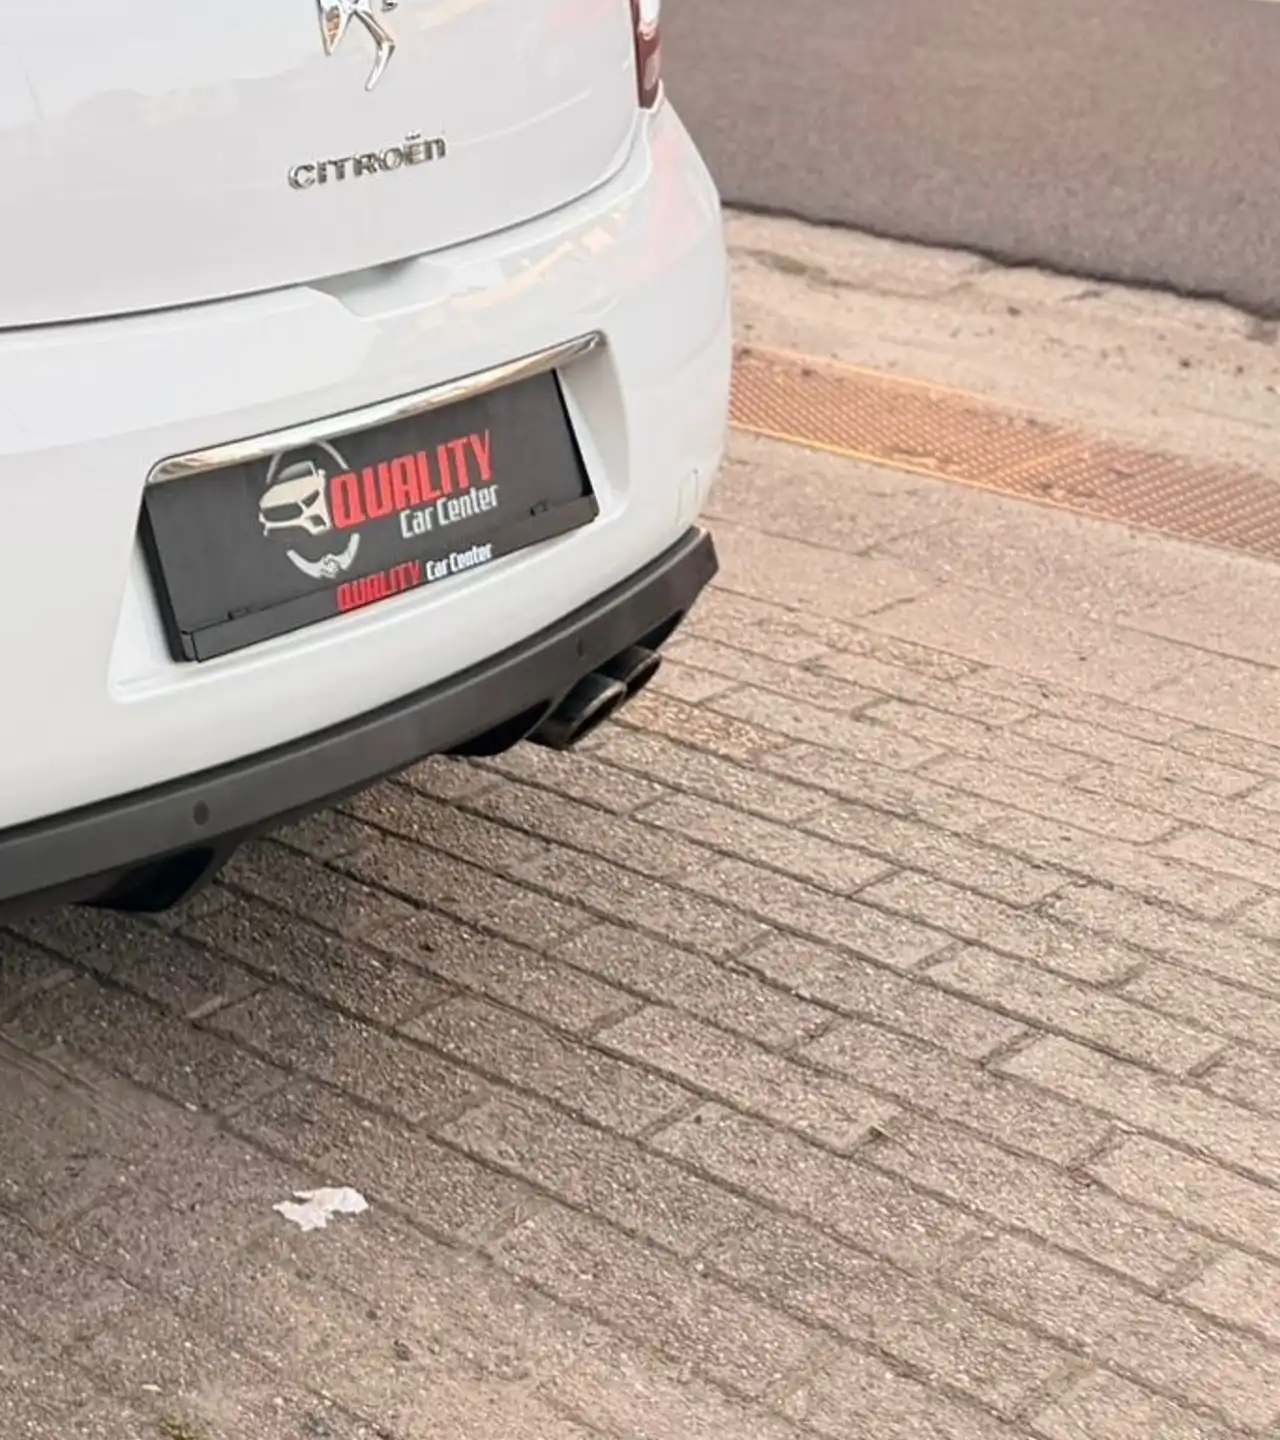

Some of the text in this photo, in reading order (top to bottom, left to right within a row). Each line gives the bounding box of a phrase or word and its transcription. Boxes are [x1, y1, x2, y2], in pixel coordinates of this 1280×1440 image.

[288, 129, 446, 190] CITROËN
[329, 428, 493, 530] QUALITY
[399, 483, 499, 539] Car Center
[337, 542, 493, 610] QUALITY Car Center
